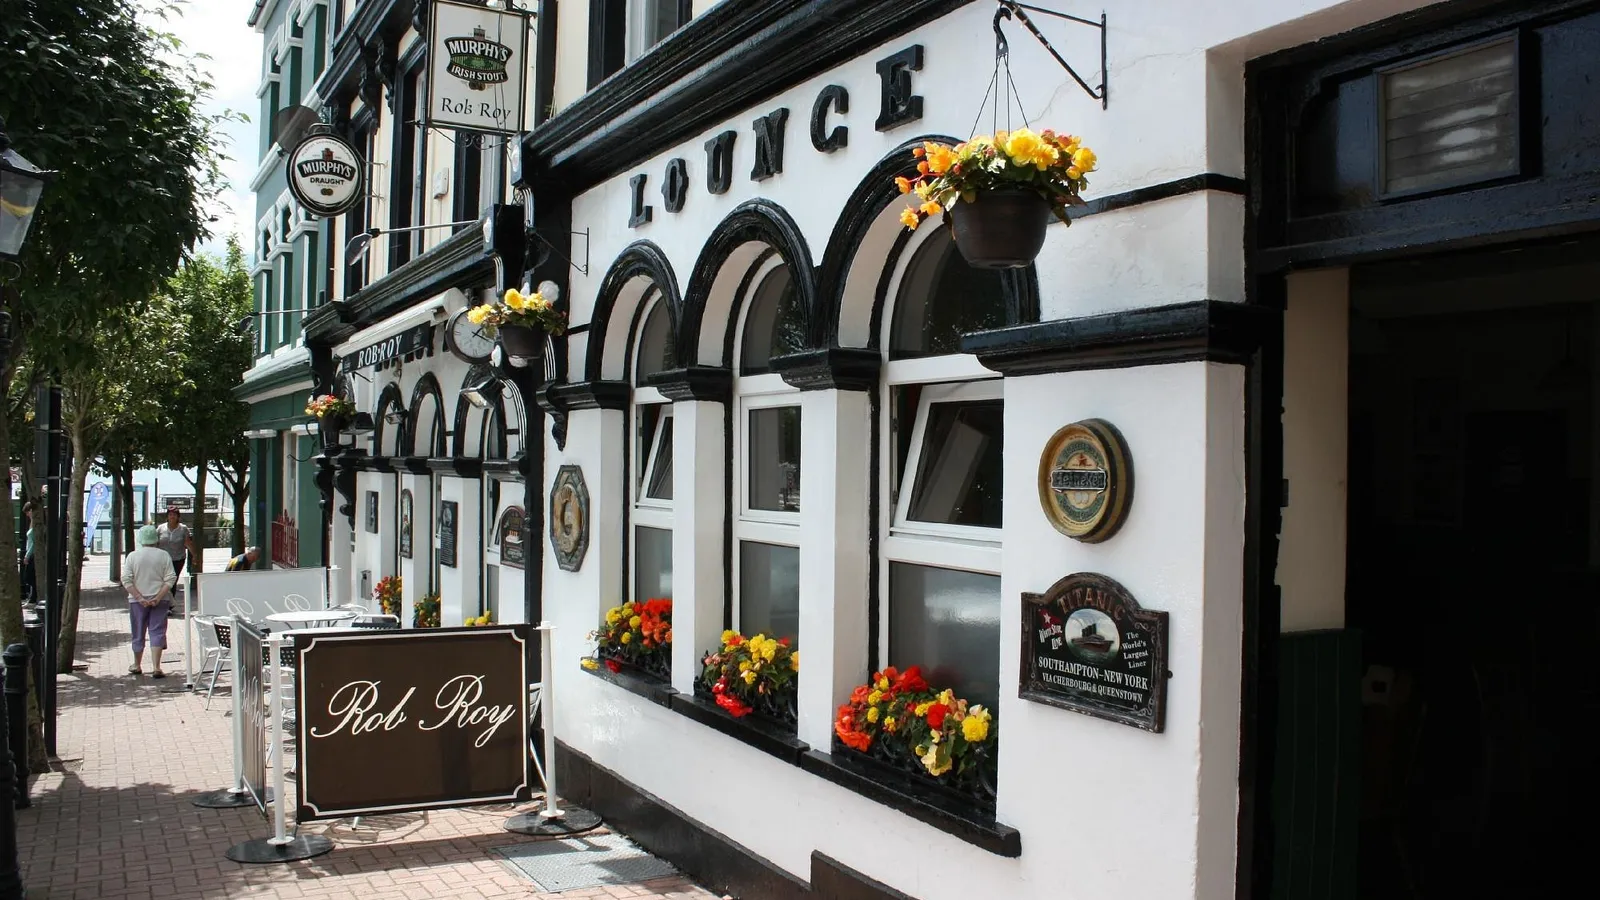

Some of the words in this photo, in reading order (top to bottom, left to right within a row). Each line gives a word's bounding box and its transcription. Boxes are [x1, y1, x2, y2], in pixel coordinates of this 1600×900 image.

[451, 65, 476, 80] IRISH
[477, 71, 505, 81] STOUT
[441, 97, 474, 115] Rob
[480, 102, 512, 125] Roy
[309, 177, 345, 186] DRAUGHT
[1057, 587, 1127, 622] TITANIC
[1126, 631, 1140, 640] The
[1122, 640, 1147, 650] World's
[1123, 650, 1149, 660] Largest
[1128, 660, 1147, 669] Liner
[1042, 672, 1053, 683] VIA
[1053, 674, 1092, 692] CHERBOURG
[1092, 683, 1098, 693] &
[1097, 685, 1144, 704] QUEENSTOWN
[1124, 673, 1149, 690] YORK
[311, 680, 417, 738] Rob
[418, 674, 517, 748] Roy
